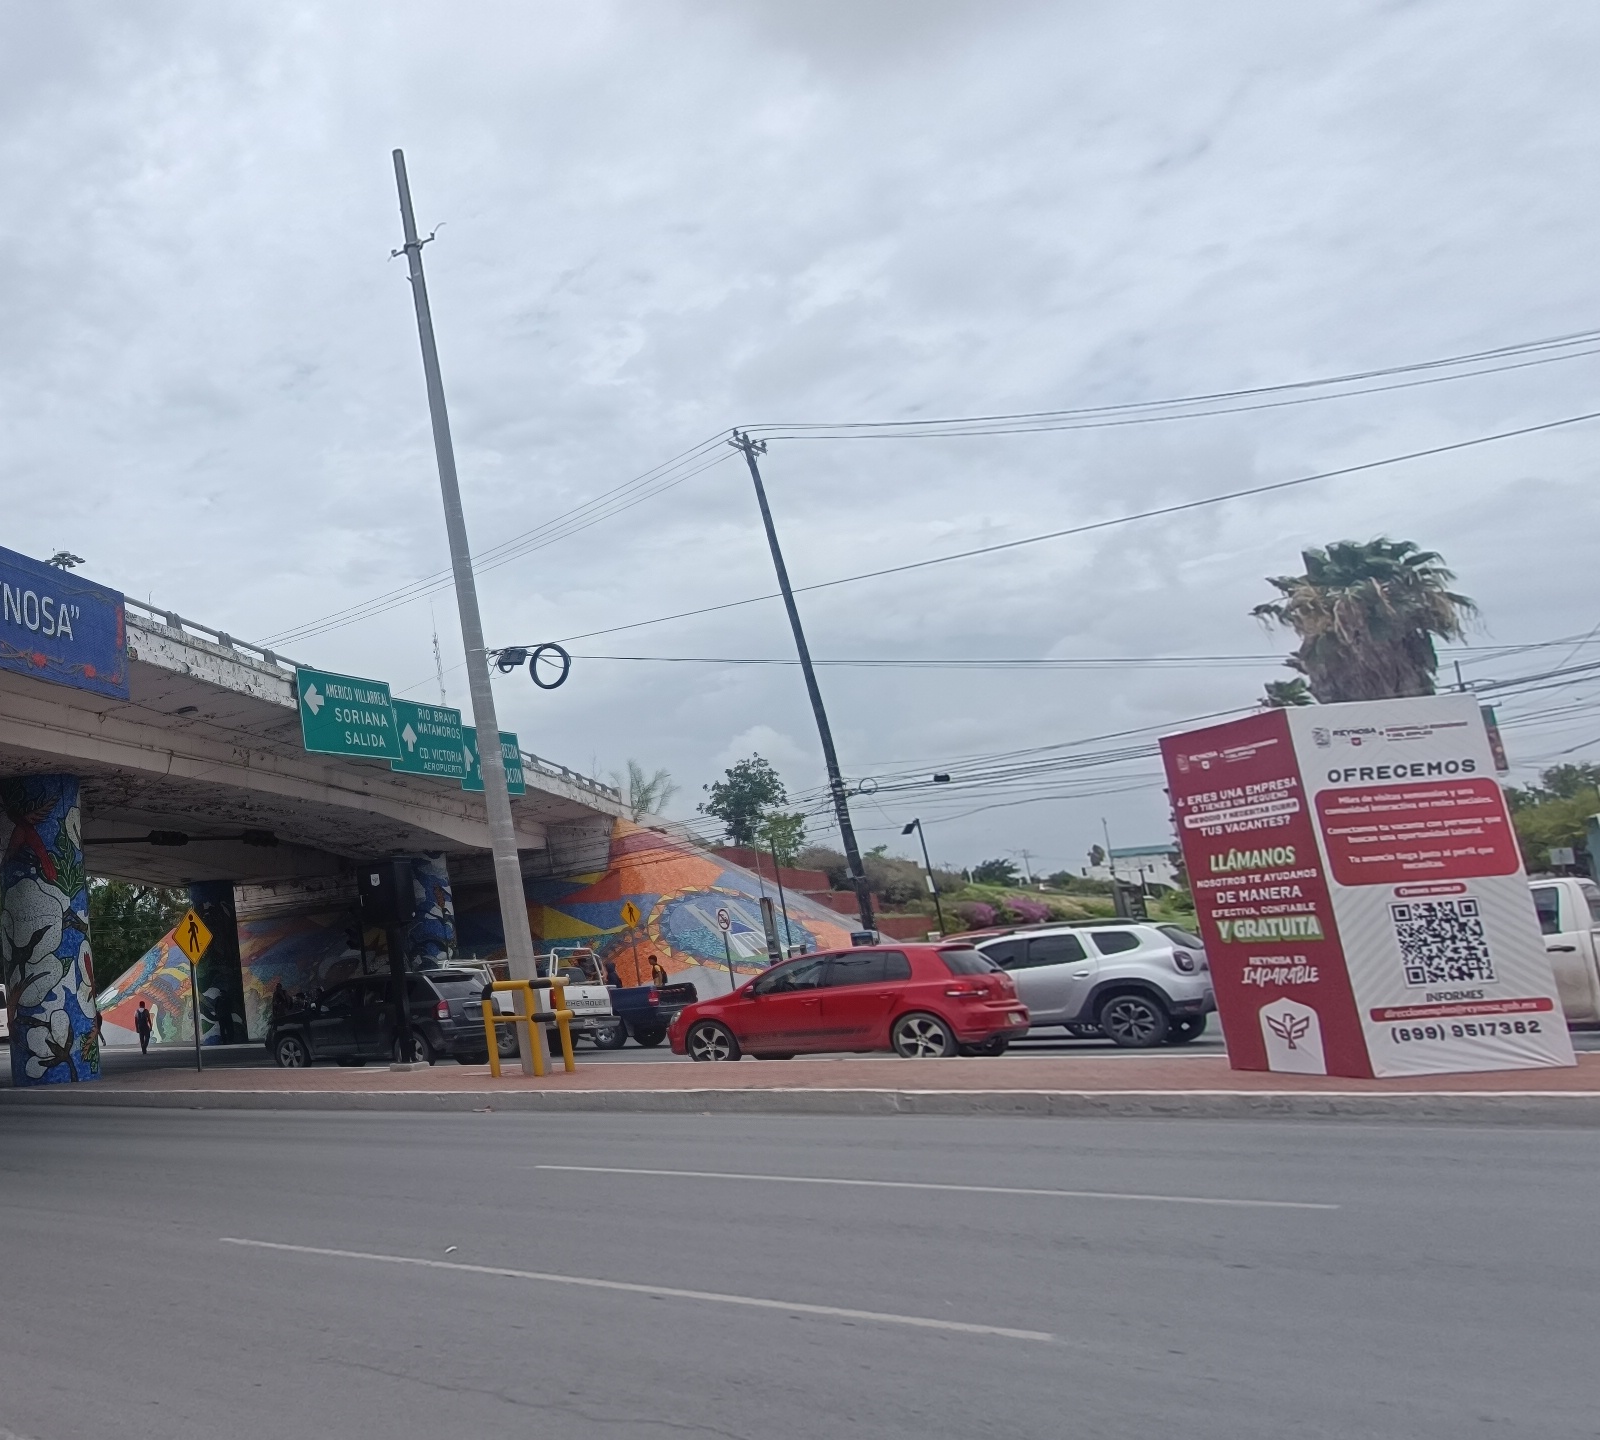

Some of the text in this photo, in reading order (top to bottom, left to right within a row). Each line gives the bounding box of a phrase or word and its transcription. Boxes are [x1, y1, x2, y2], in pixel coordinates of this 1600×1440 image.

[325, 683, 390, 706] AMERICO VILLARREAL
[335, 707, 388, 728] SORIANA
[418, 708, 457, 725] RIO BRAVO
[345, 731, 386, 748] SALIDA
[418, 722, 460, 739] MATAMOROS
[420, 748, 462, 763] CD. VICTORIA
[423, 762, 462, 774] AEROPUERTO
[1327, 759, 1476, 783] OFRECEMOS
[1187, 792, 1218, 806] ERES
[1220, 788, 1244, 800] UNA
[1245, 777, 1297, 795] EMPRESA
[1200, 801, 1232, 812] TIENES
[1234, 797, 1245, 806] UN
[1200, 815, 1291, 837] TUS VACANTES?
[1210, 846, 1296, 872] LLÁMANOS
[1196, 868, 1317, 888] NOSOTROS TE AYUDAMOS
[1216, 885, 1302, 904] DE MANERA
[1212, 902, 1316, 918] EFECTIVA, CONFIABLE
[1216, 915, 1321, 940] Y GRATUITA
[1294, 955, 1306, 964] ES
[1426, 989, 1484, 1002] INFORMES
[1391, 1020, 1542, 1044] (899) 9517382
